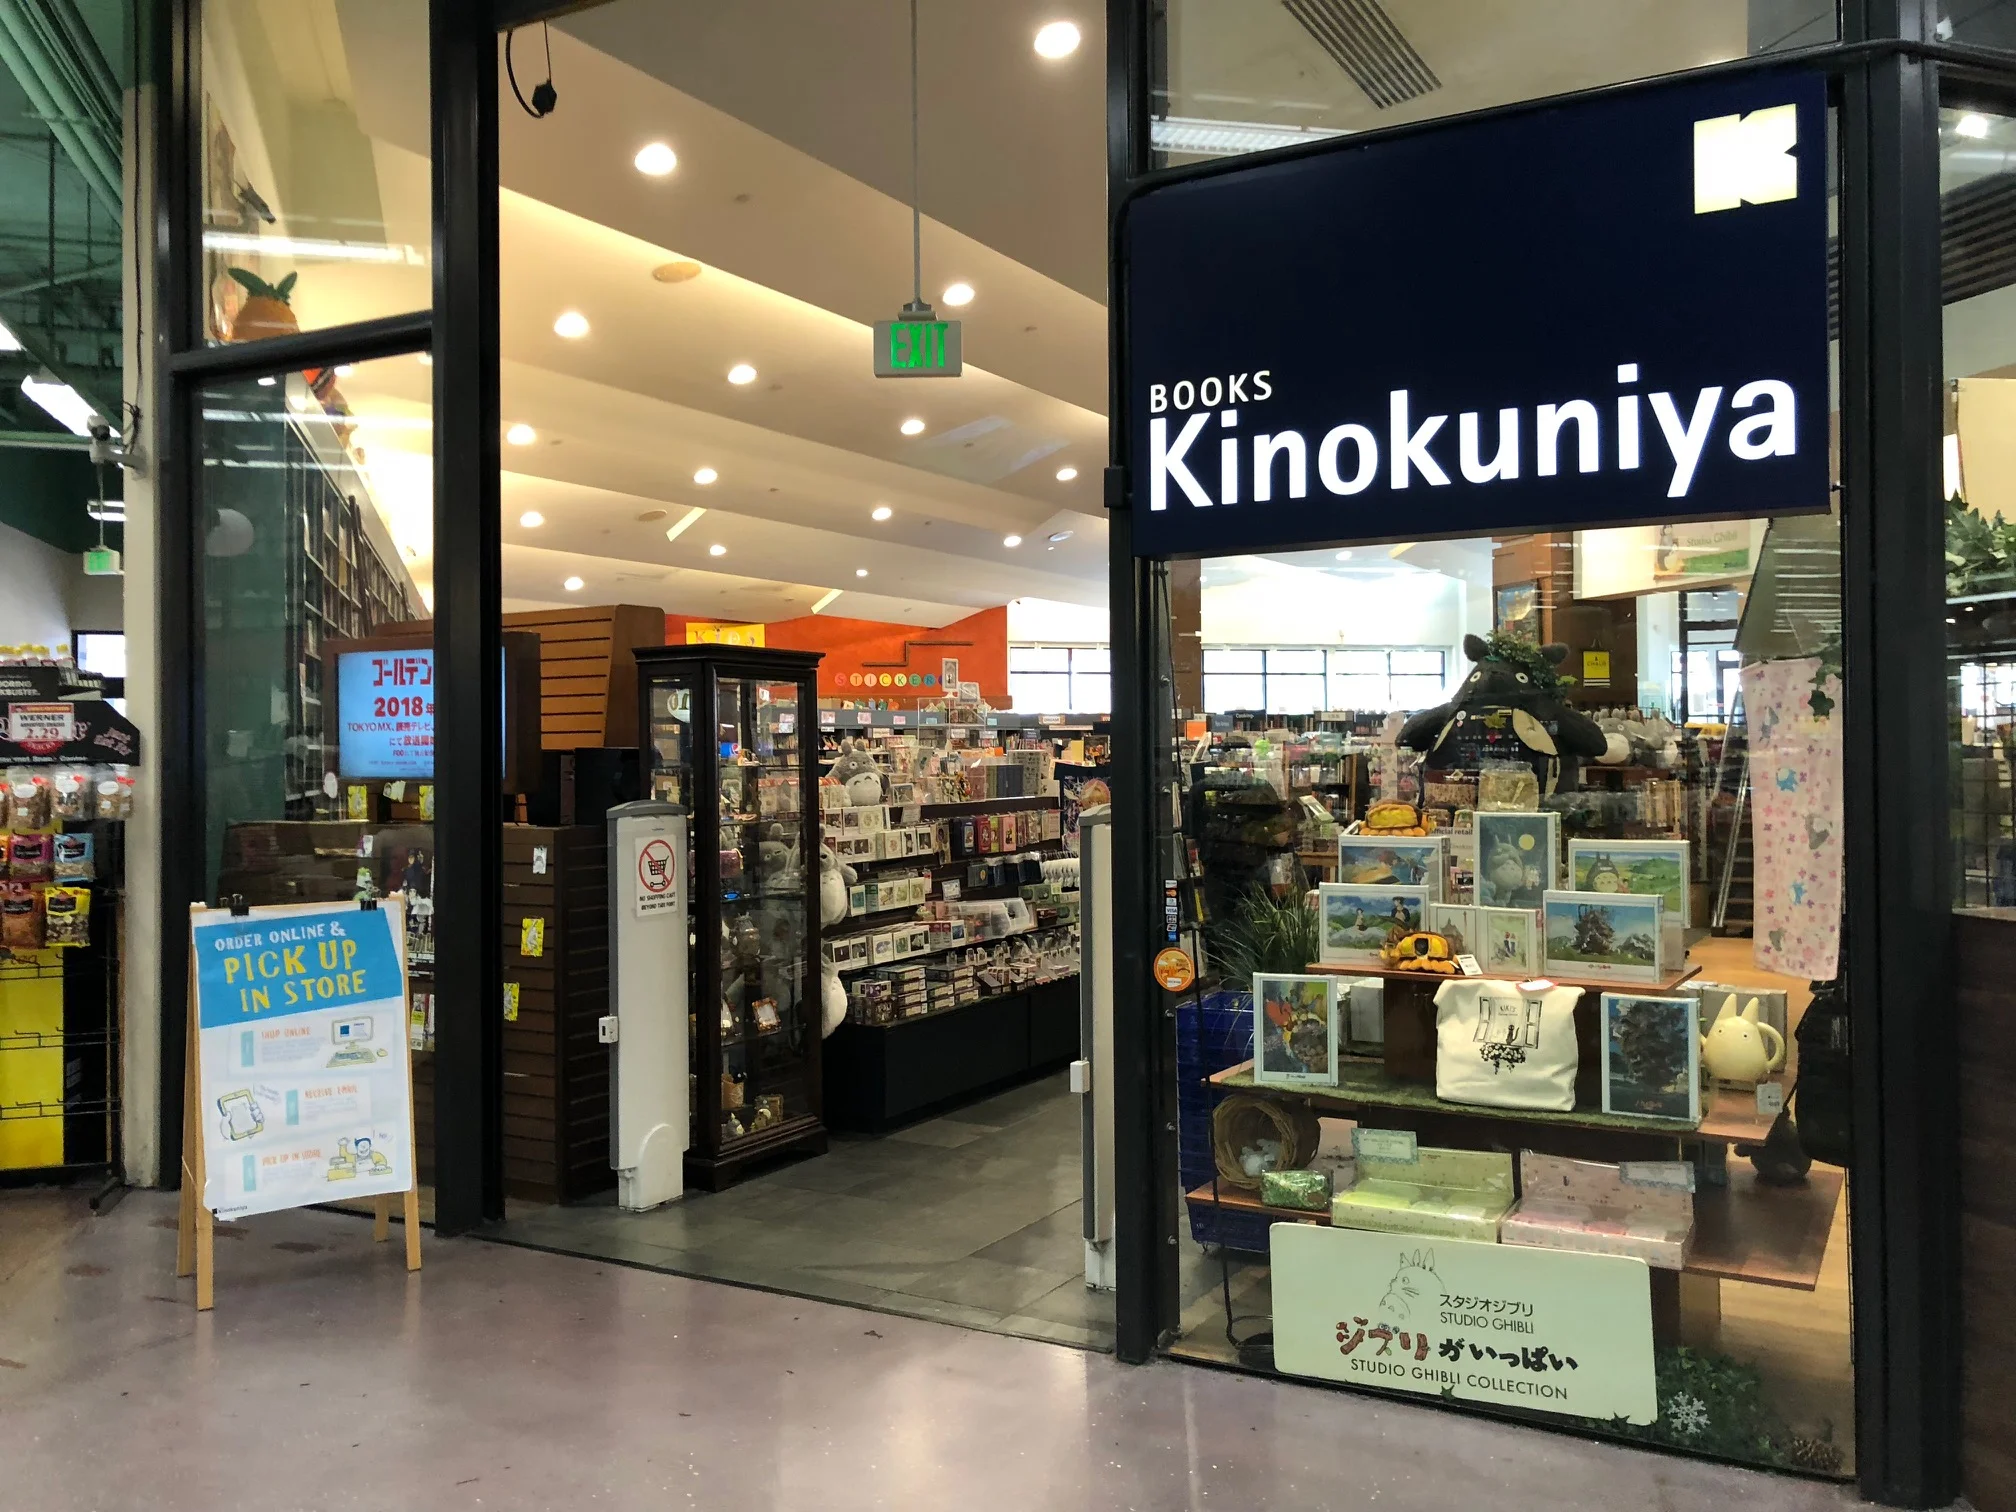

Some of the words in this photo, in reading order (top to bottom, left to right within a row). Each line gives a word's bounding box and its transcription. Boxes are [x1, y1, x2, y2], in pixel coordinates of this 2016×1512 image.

[890, 323, 949, 368] EXIT
[1150, 370, 1272, 413] BOOKS
[1150, 363, 1796, 511] Kinokuniya
[837, 673, 943, 688] STICKER
[25, 727, 60, 739] 2.29
[215, 933, 262, 951] ORDER
[269, 923, 325, 944] ONLINE
[330, 921, 346, 937] &
[224, 946, 307, 985] PICK
[318, 939, 357, 970] UP
[240, 985, 271, 1013] IN
[283, 969, 366, 1005] STORE
[1440, 1293, 1534, 1317] スタジオジブリ
[1440, 1311, 1488, 1329] STUDIO
[1492, 1318, 1534, 1334] GHIBLI
[1350, 1358, 1406, 1377] STUDIO
[1411, 1367, 1460, 1385] GHIBLI
[1466, 1374, 1568, 1400] COLLECTION
